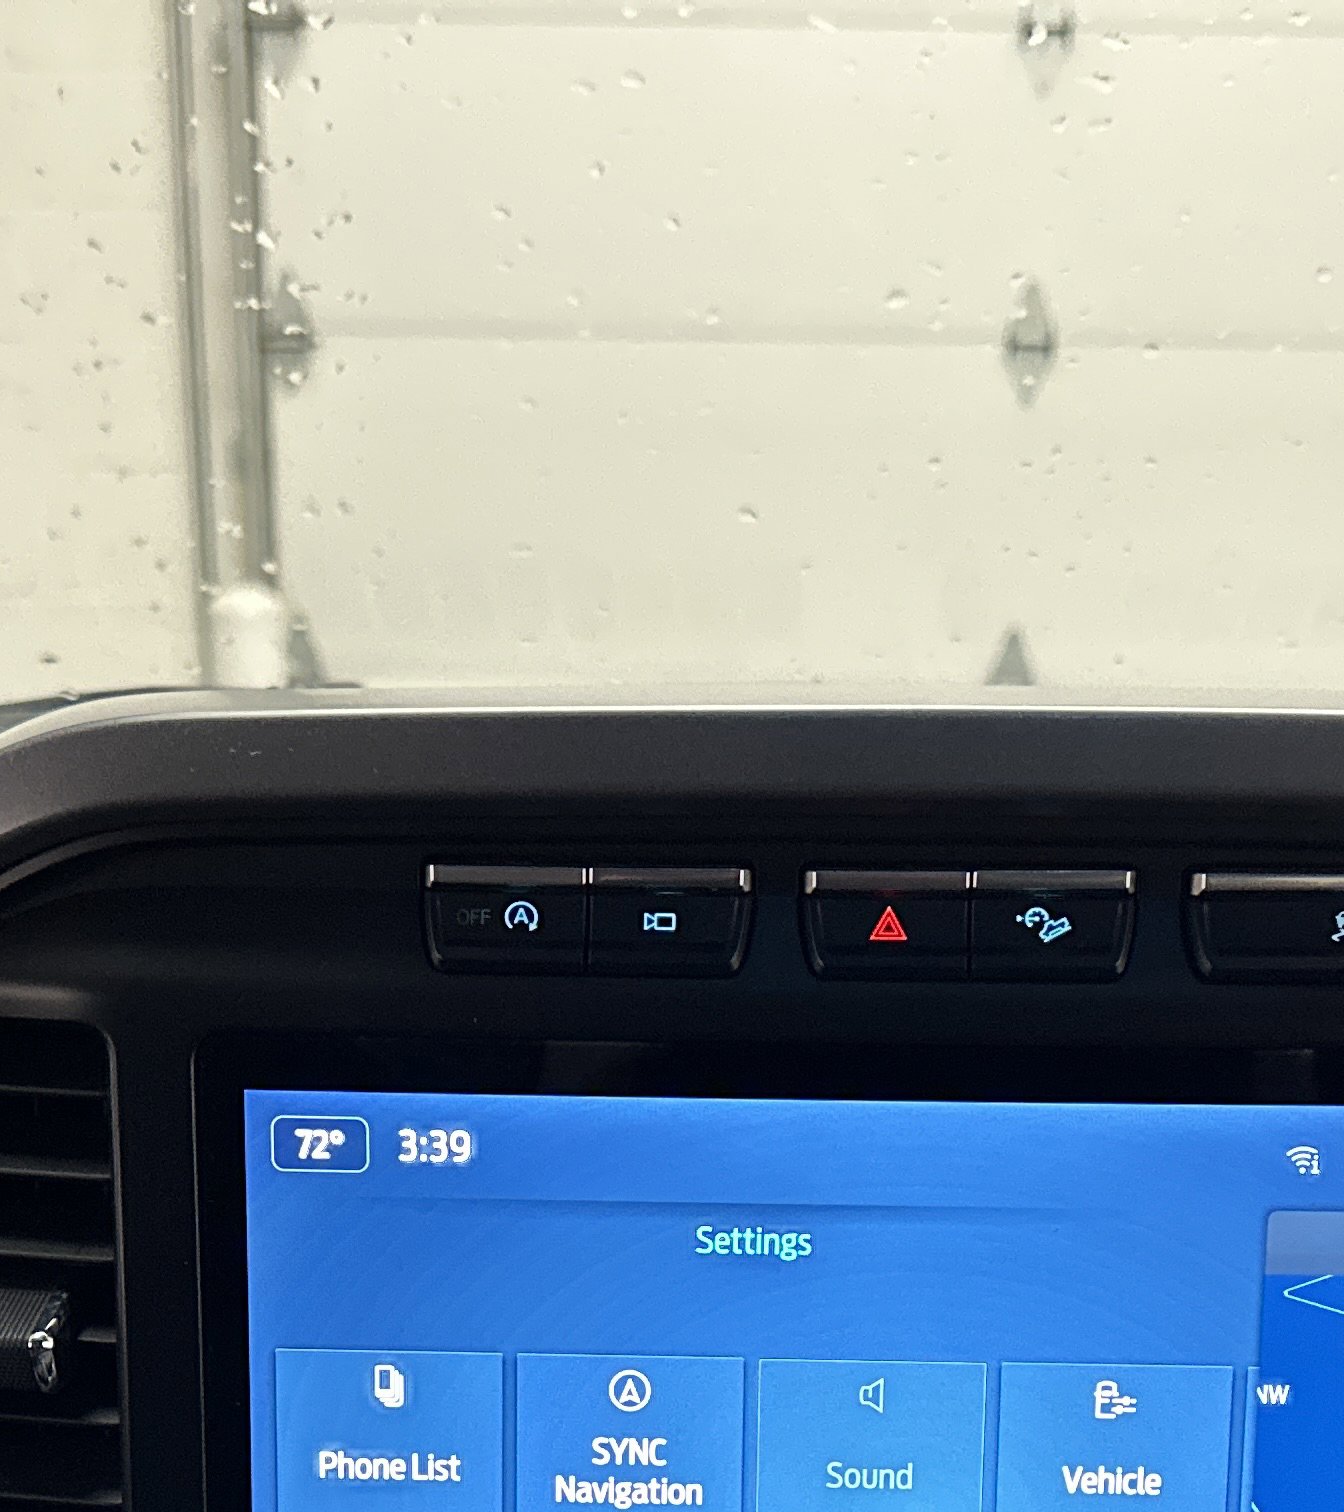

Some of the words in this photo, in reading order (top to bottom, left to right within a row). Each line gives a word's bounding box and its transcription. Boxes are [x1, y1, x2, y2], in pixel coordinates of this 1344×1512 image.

[458, 909, 492, 926] OFF
[396, 1128, 473, 1165] 3:39
[695, 1225, 813, 1262] Settings
[317, 1451, 406, 1482] Phone
[411, 1452, 462, 1484] List
[591, 1437, 668, 1468] SYNC
[554, 1476, 704, 1510] Navigation
[825, 1461, 914, 1492] Sound
[1062, 1465, 1163, 1498] Vehicle
